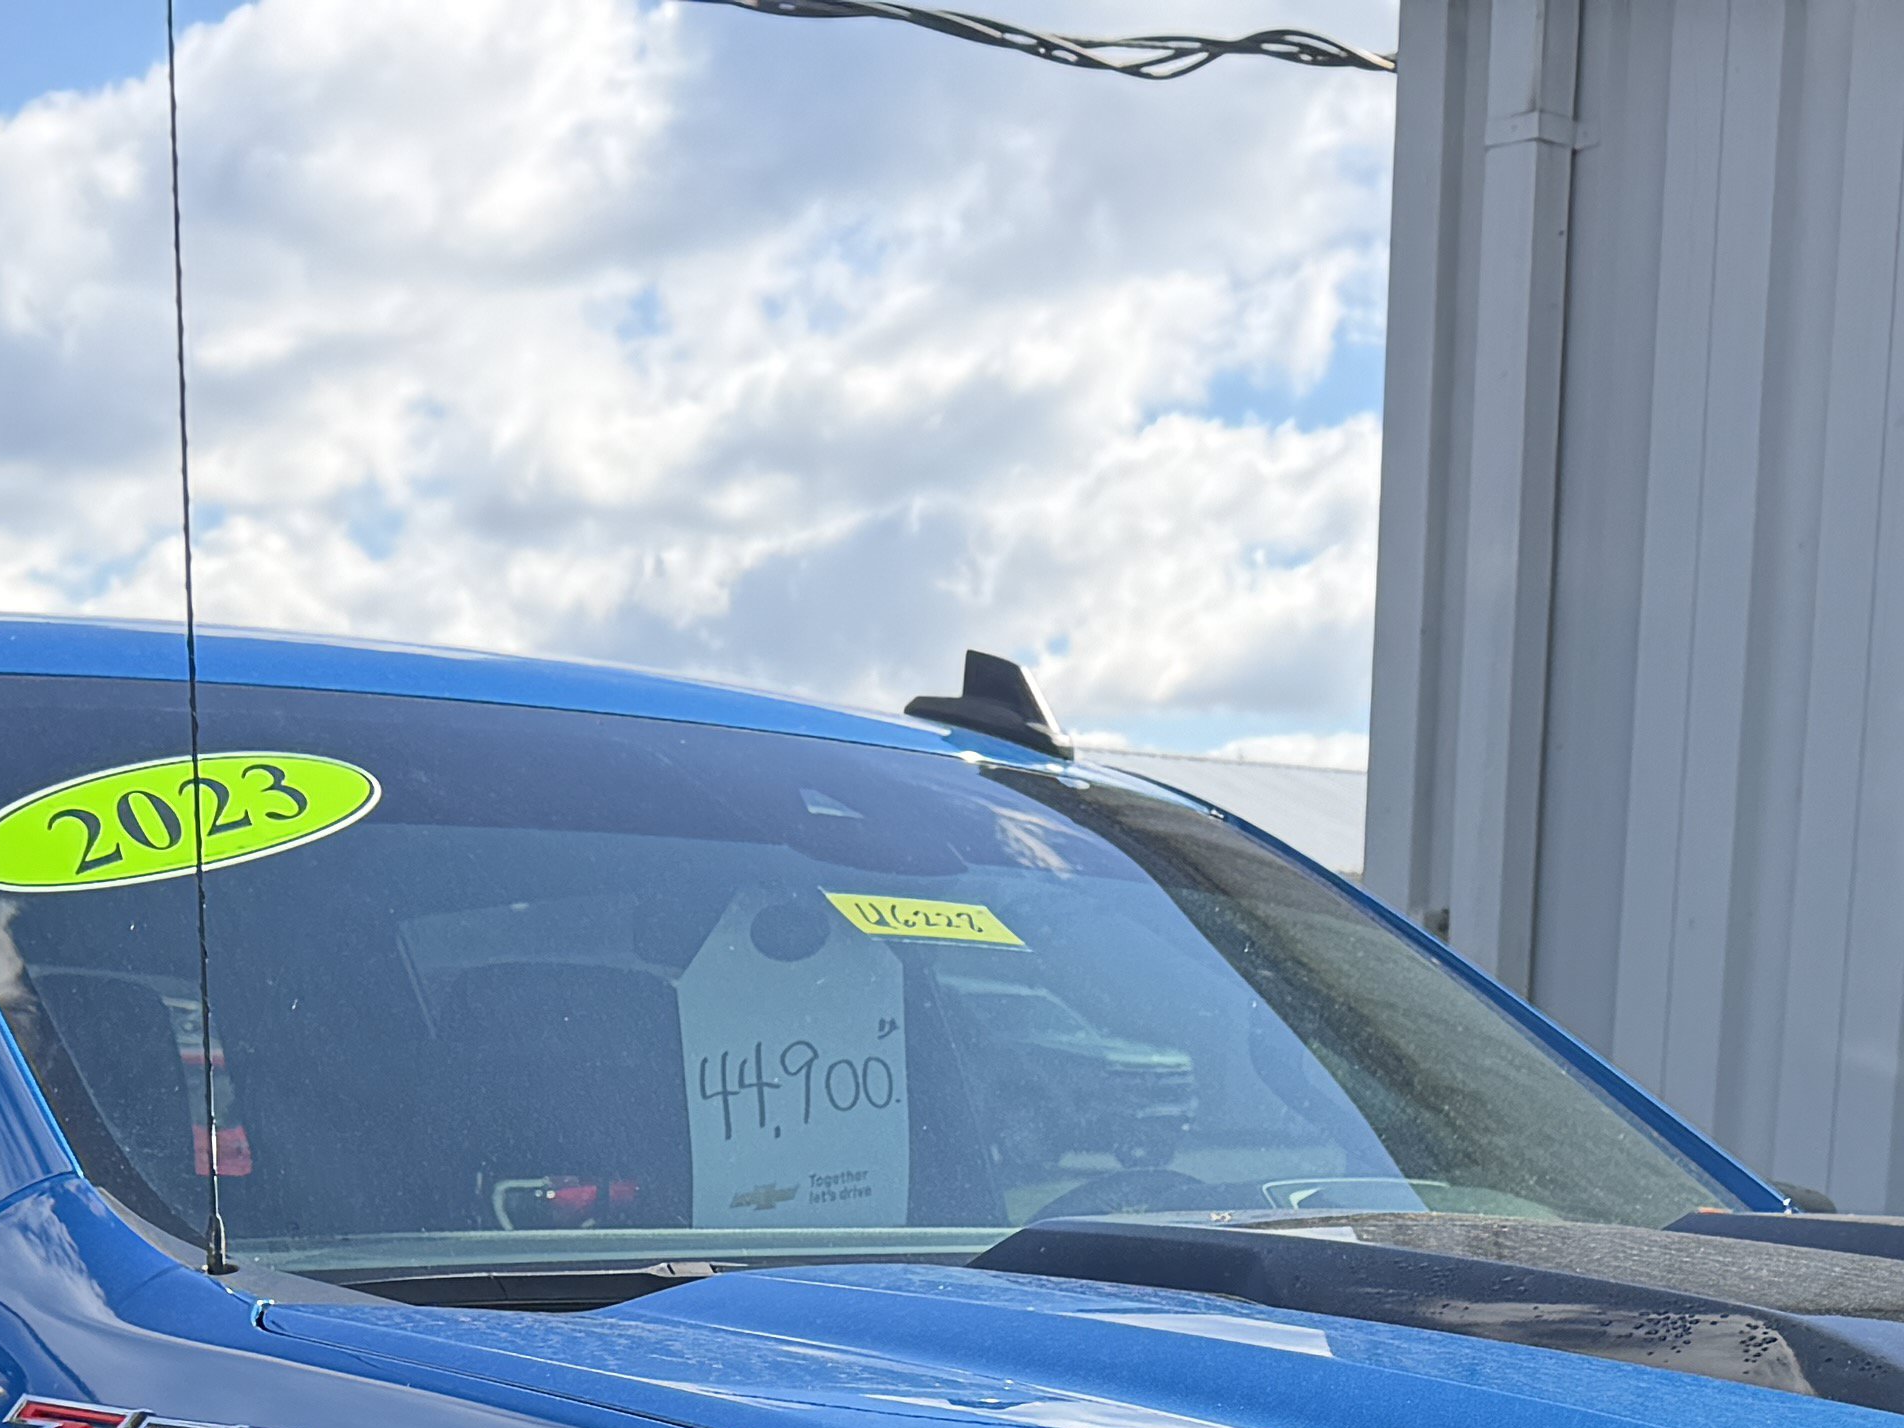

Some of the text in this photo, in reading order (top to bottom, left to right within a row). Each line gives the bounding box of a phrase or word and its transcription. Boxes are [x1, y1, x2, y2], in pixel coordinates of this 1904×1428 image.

[48, 764, 308, 875] 2023
[808, 1170, 868, 1188] Together
[839, 1185, 872, 1201] drive
